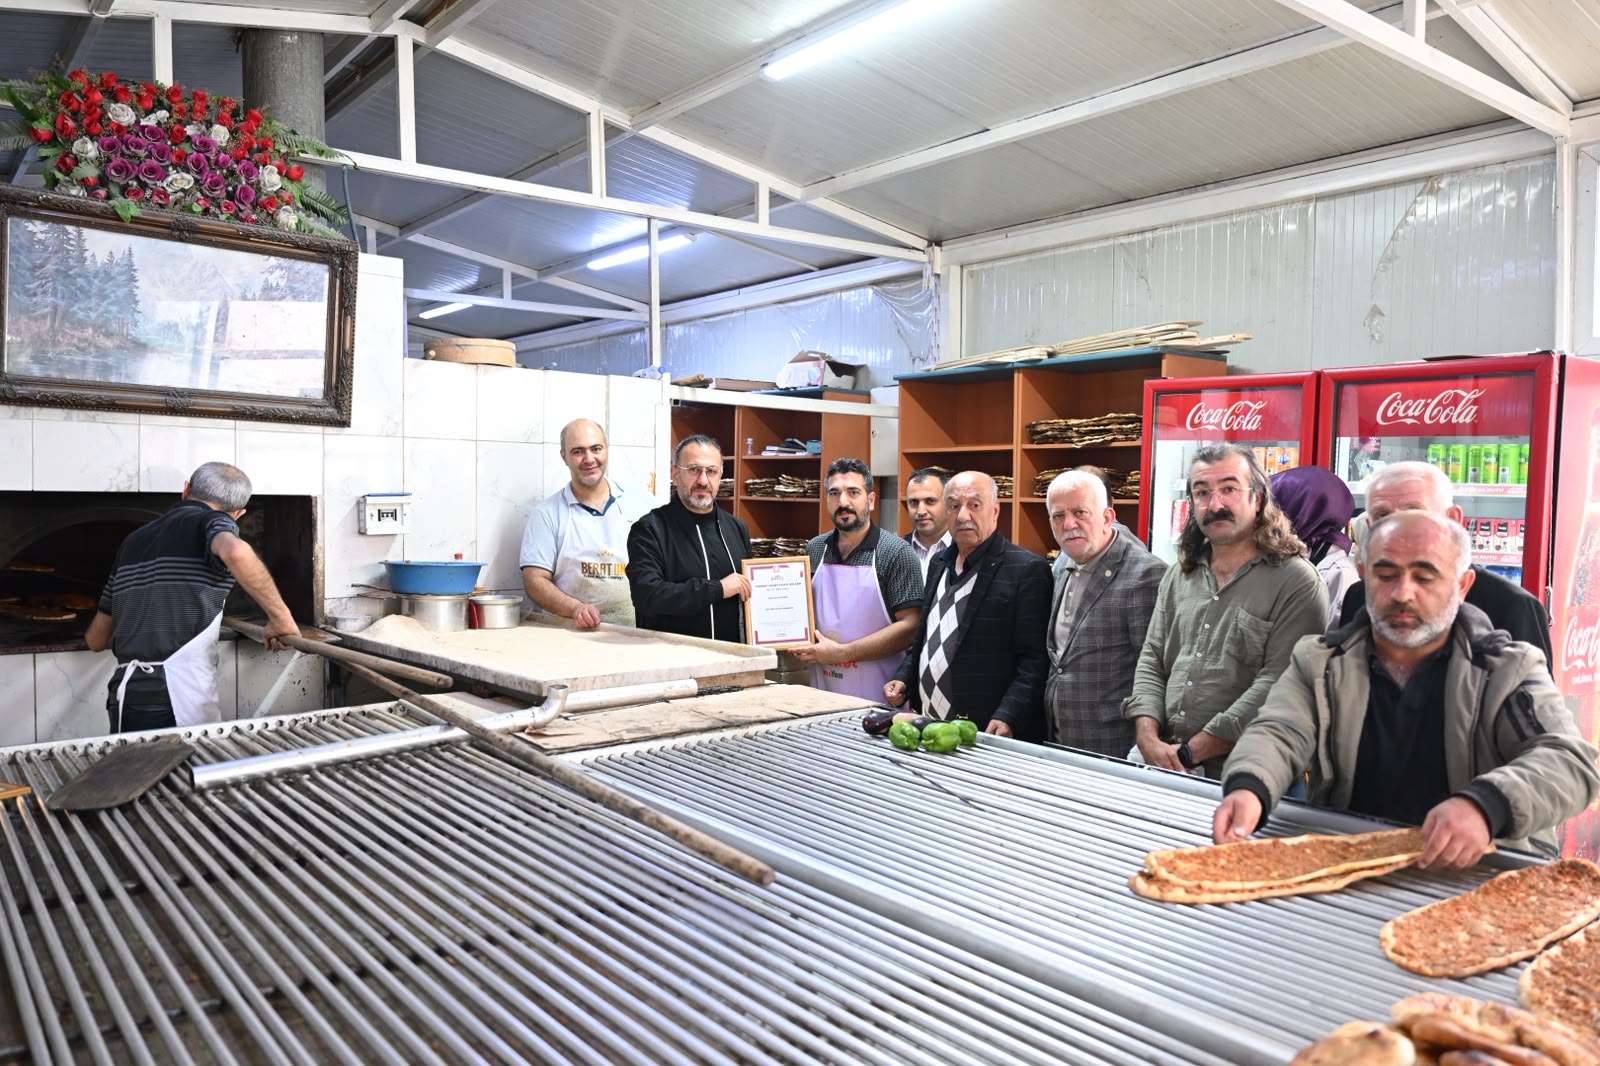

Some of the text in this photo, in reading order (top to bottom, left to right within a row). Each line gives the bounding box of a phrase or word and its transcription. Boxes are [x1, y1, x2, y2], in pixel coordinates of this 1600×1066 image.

[1186, 400, 1267, 431] Coca-Cola
[1376, 388, 1486, 426] Coca-Cola
[581, 562, 612, 576] BERAT
